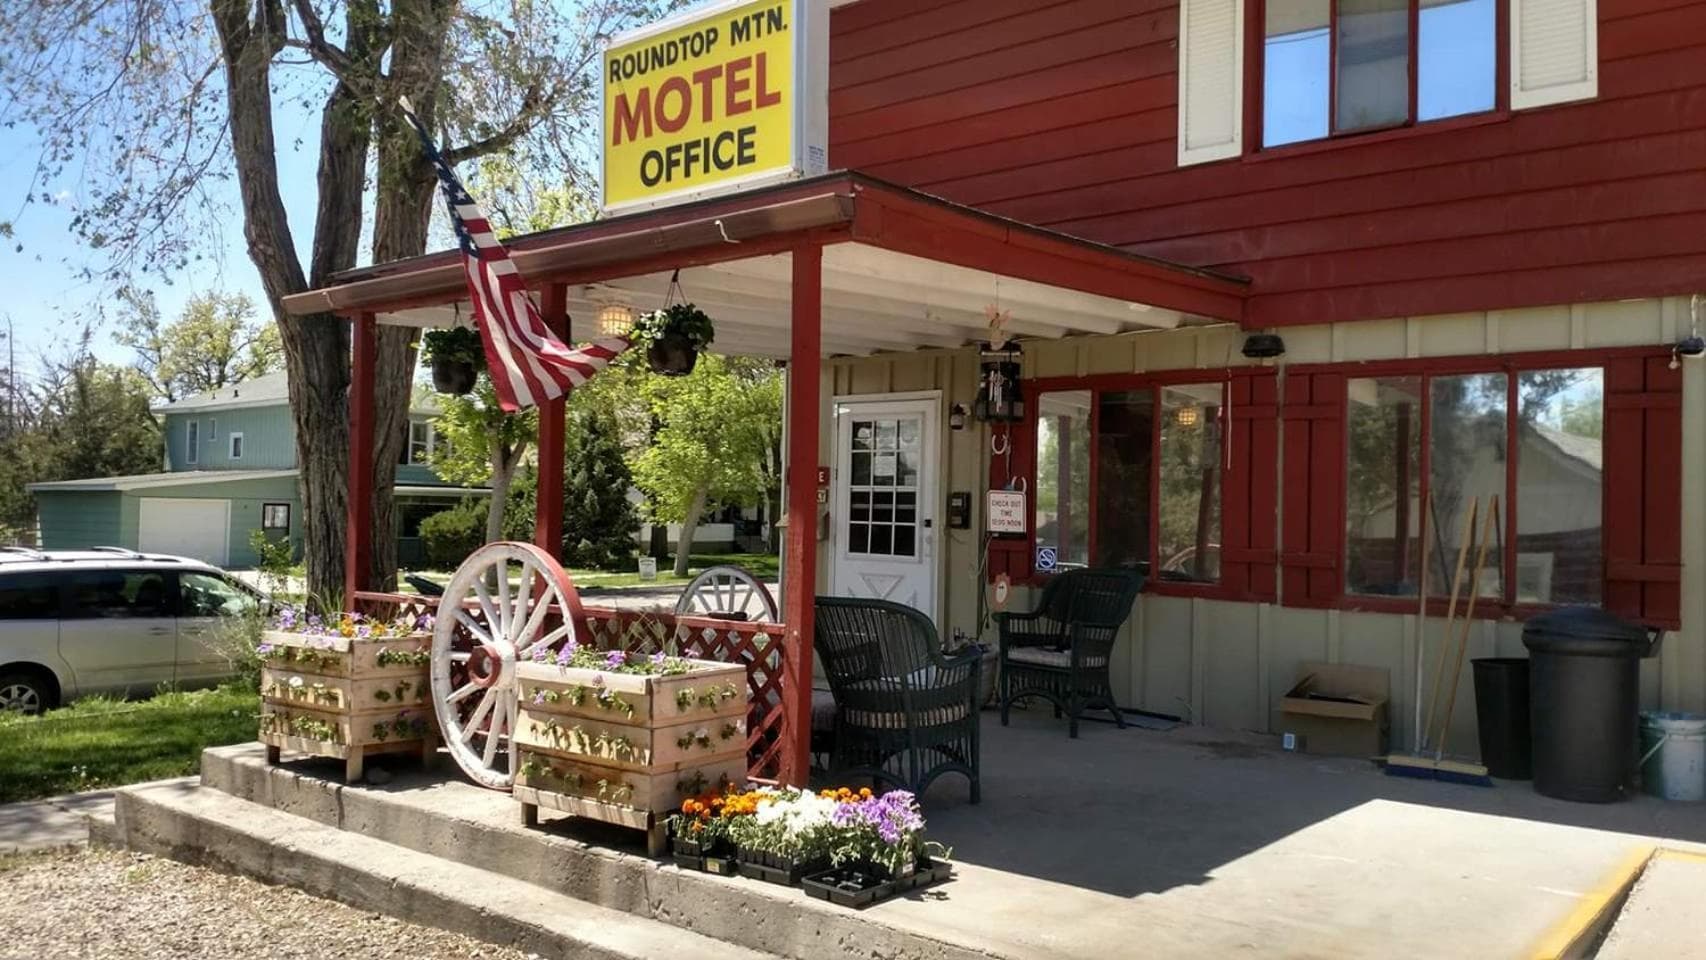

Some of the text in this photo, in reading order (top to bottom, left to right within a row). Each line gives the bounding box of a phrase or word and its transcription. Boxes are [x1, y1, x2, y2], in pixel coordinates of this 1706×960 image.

[609, 6, 787, 83] ROUNDTOP MTN.
[612, 52, 781, 146] MOTEL
[640, 126, 756, 187] OFFICE
